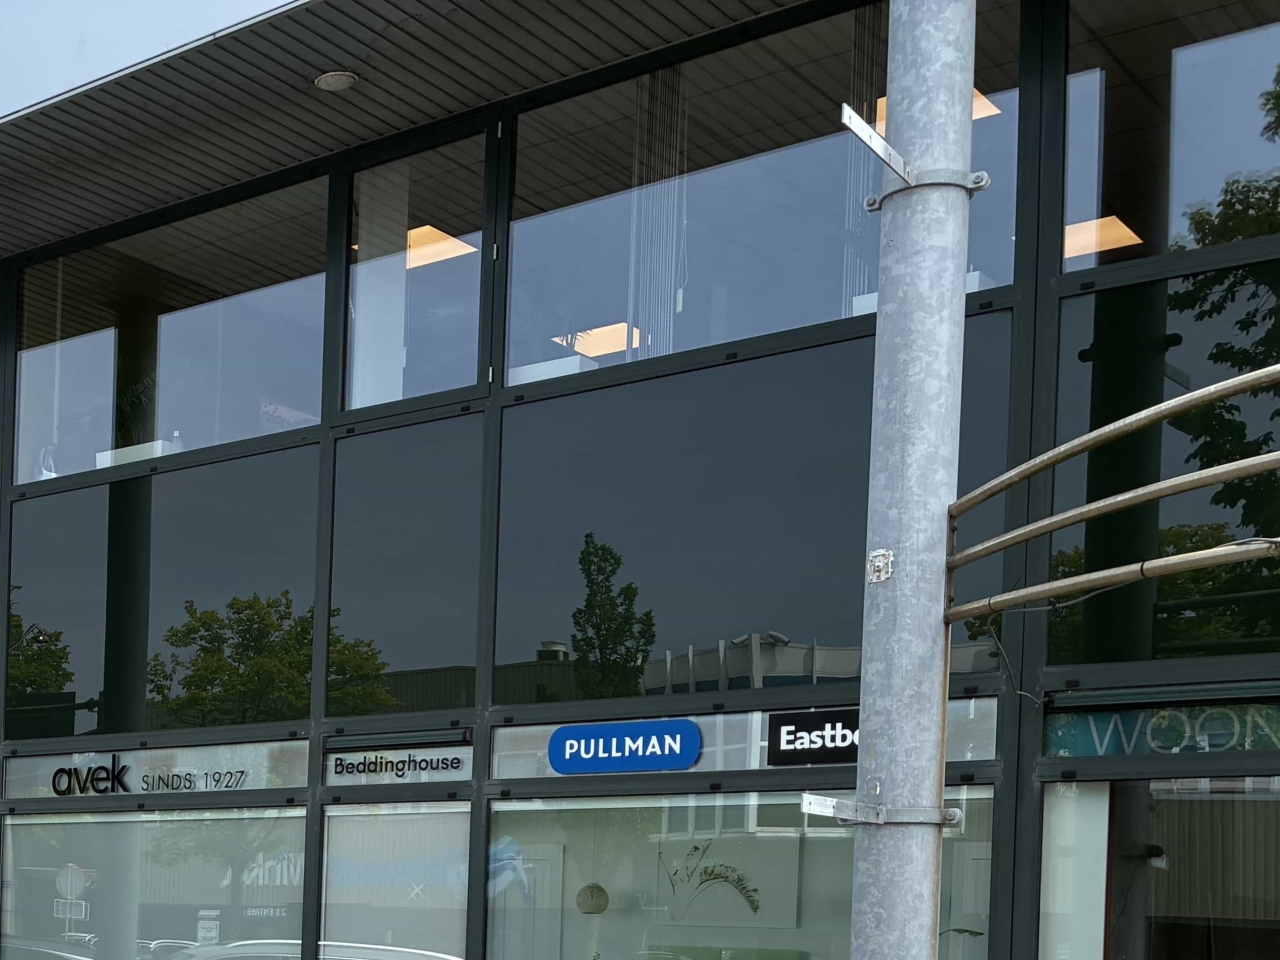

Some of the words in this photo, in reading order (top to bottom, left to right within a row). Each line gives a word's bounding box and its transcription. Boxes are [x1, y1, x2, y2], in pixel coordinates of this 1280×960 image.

[564, 734, 682, 760] PULLMAN
[51, 753, 130, 796] avek
[140, 773, 194, 791] SINDS
[203, 770, 244, 789] 1927
[333, 754, 462, 778] Beddinghouse
